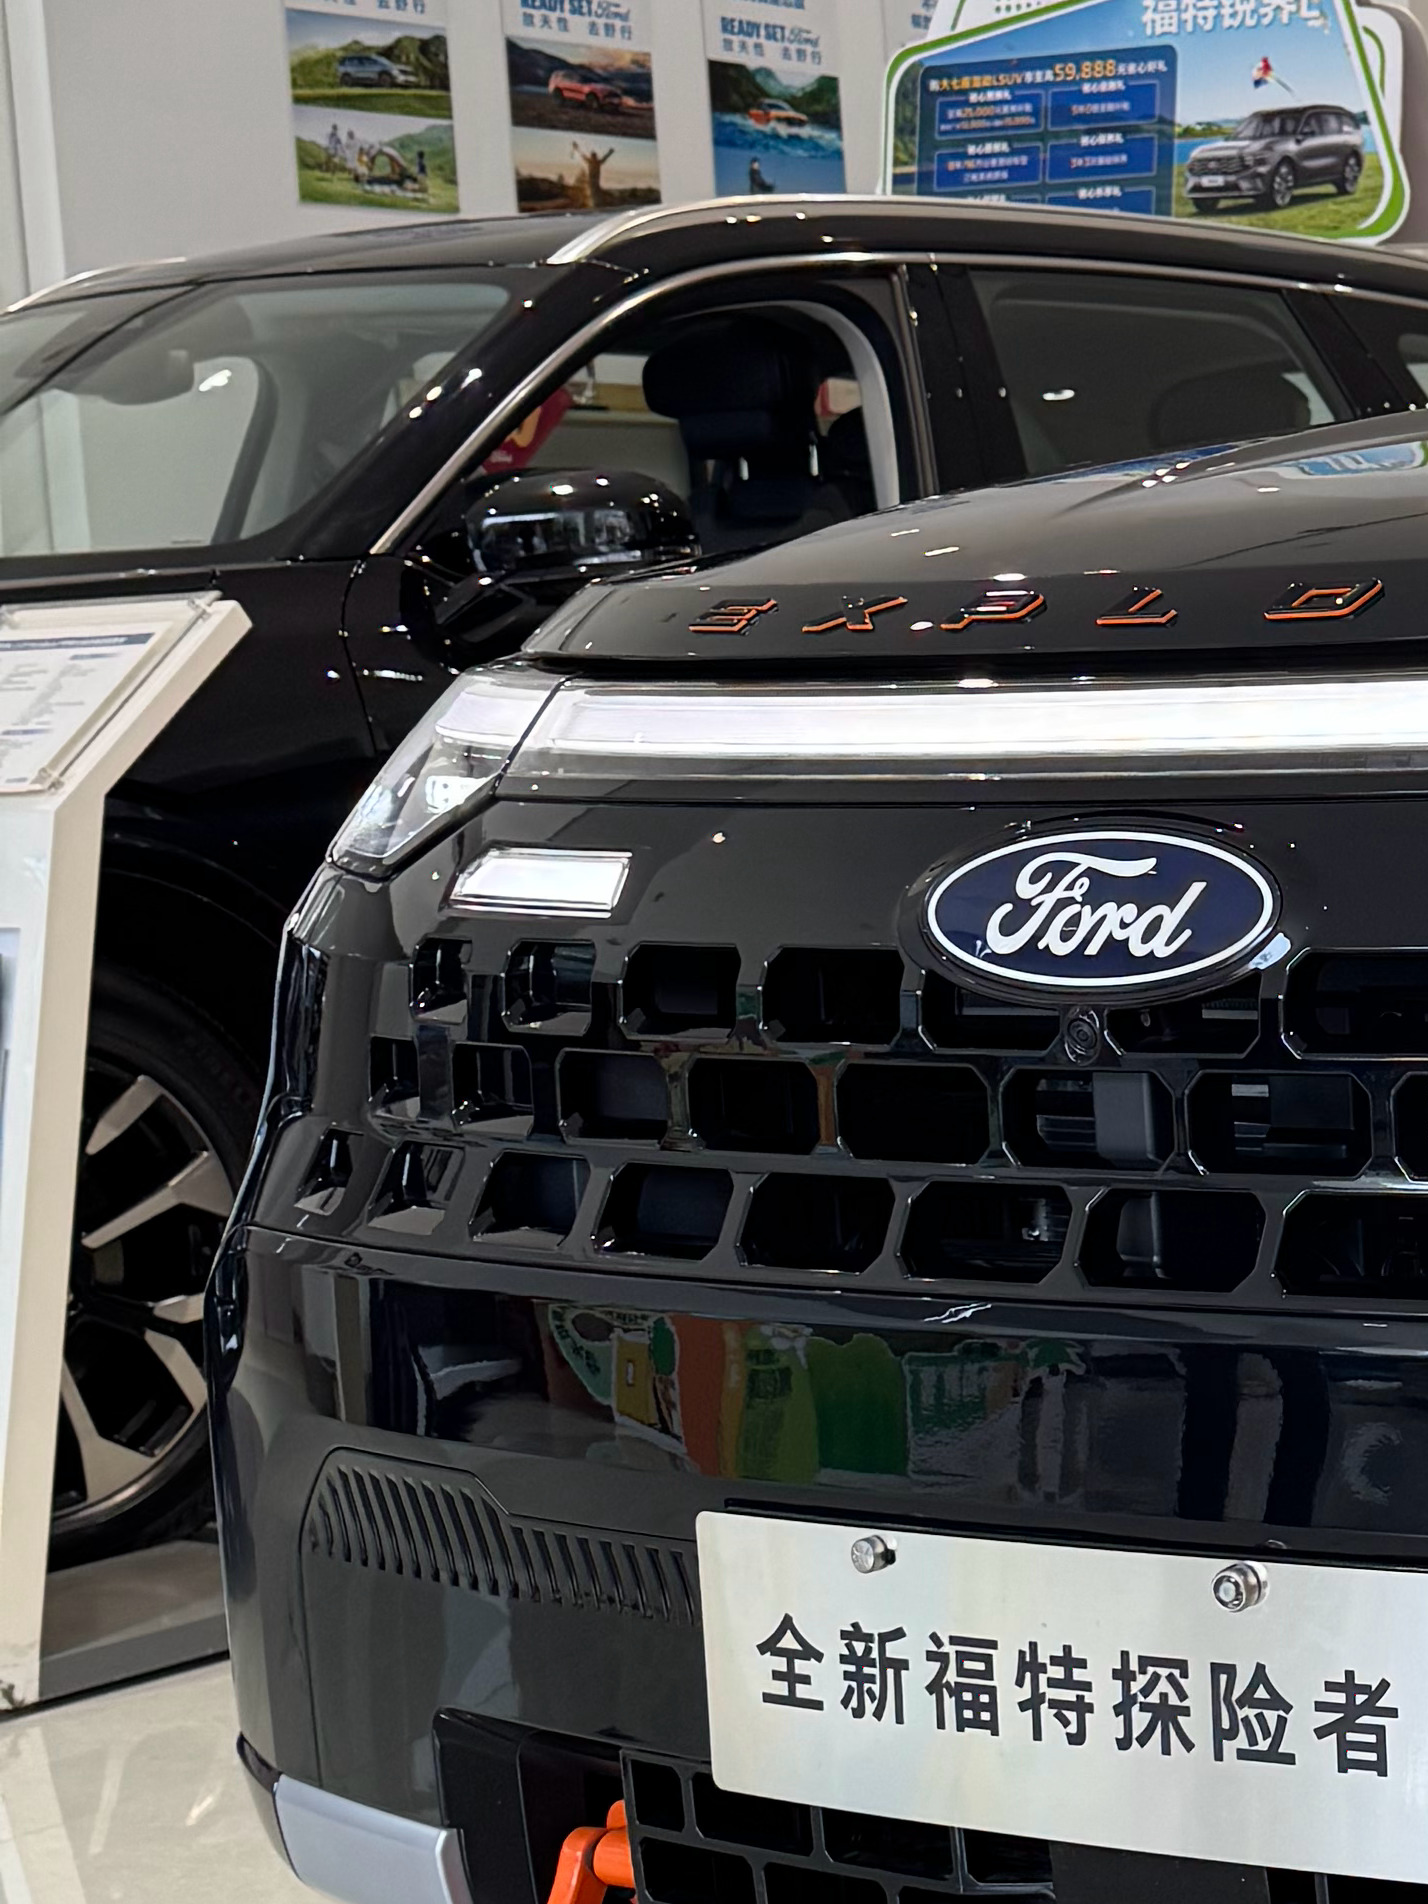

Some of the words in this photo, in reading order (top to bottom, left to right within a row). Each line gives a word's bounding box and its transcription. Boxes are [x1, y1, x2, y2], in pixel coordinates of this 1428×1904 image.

[594, 0, 631, 22] Ford
[721, 16, 761, 40] READY
[765, 23, 786, 43] SET
[986, 851, 1206, 960] Ford
[756, 1613, 1400, 1778] 全新福特探险者
